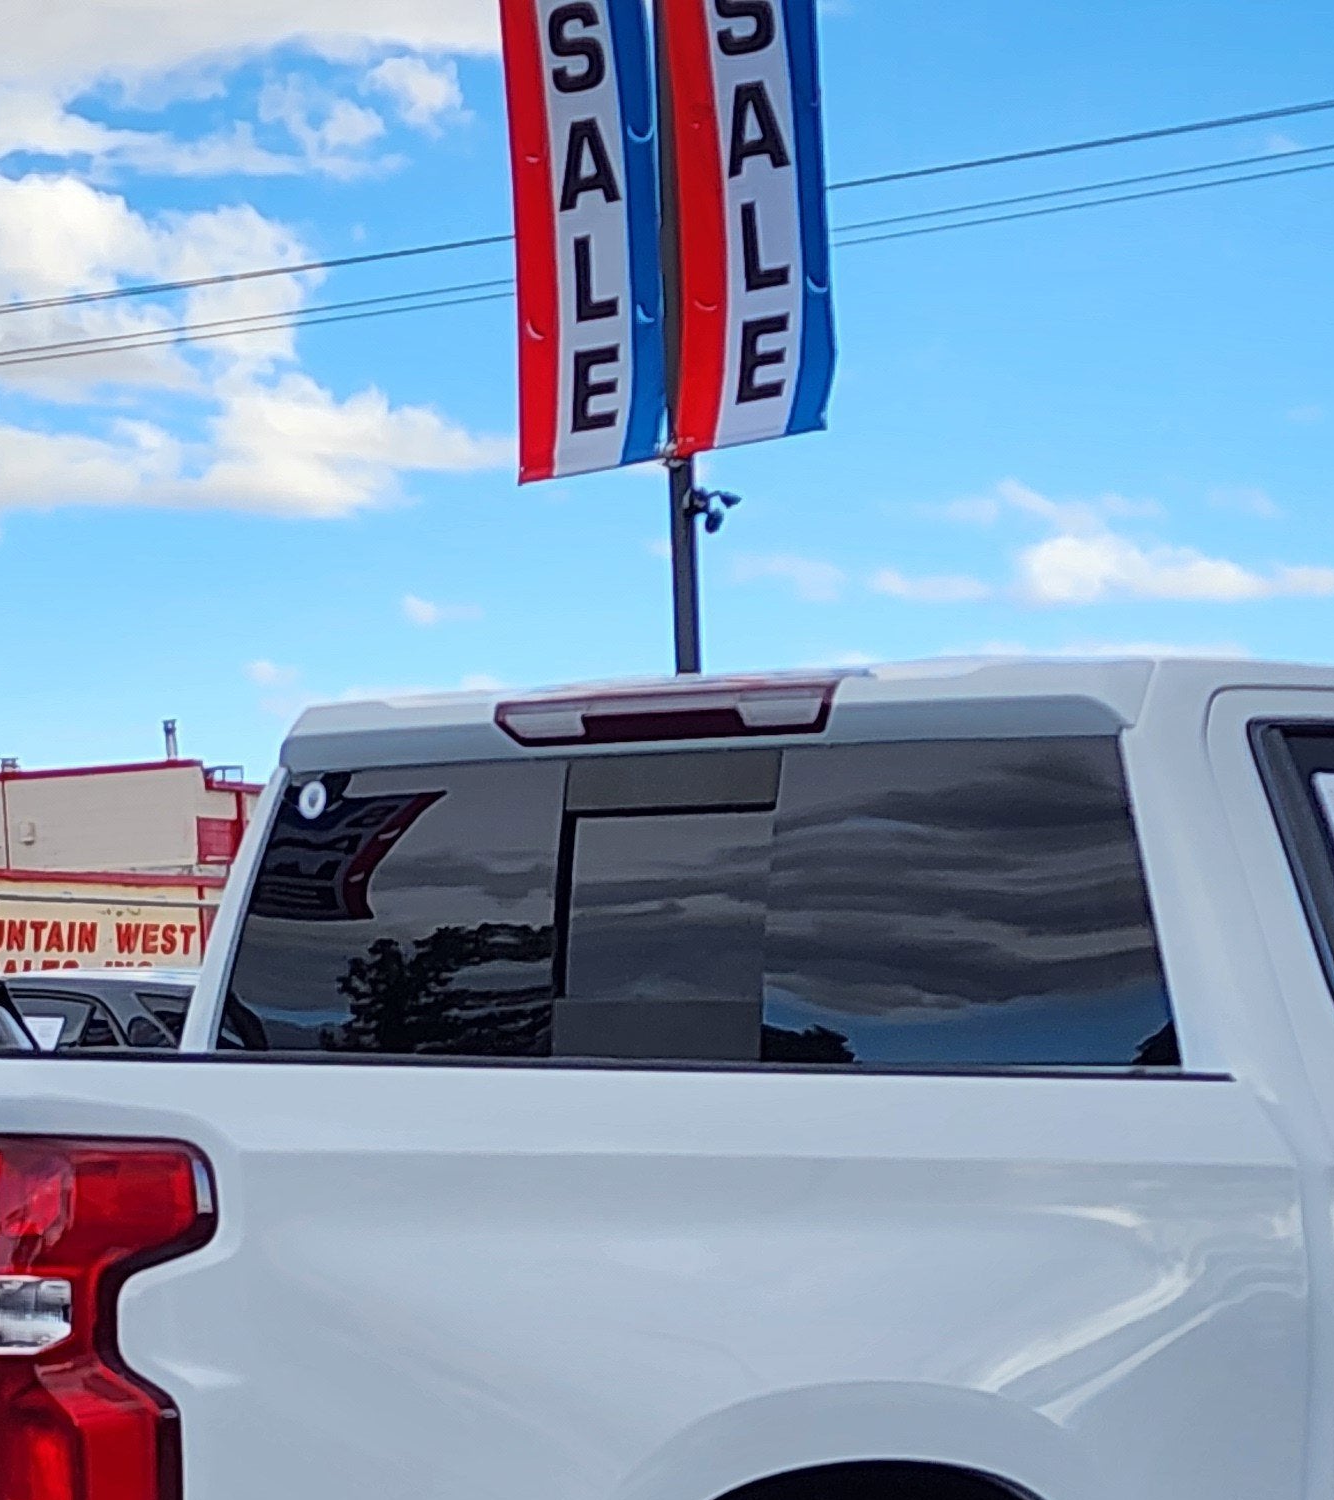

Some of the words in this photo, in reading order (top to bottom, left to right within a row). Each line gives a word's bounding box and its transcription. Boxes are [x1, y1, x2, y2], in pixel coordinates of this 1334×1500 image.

[548, 3, 622, 434] SALE
[715, 0, 791, 405] SALE
[115, 921, 197, 955] WEST
